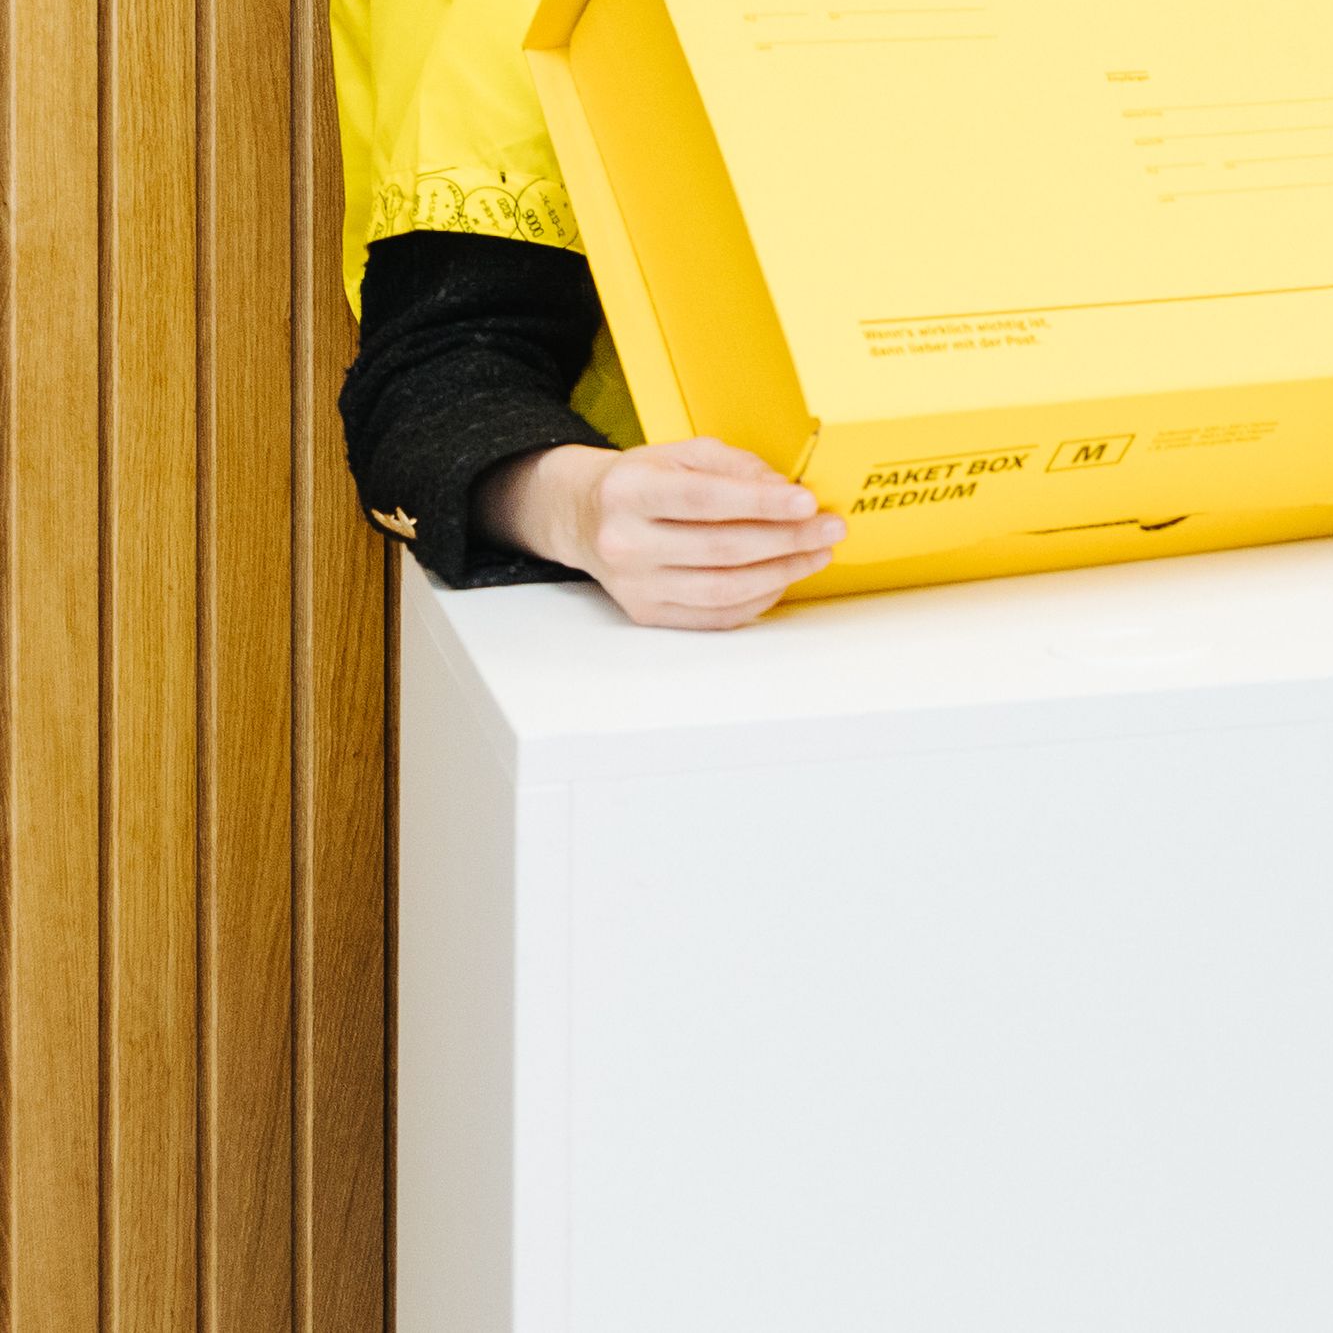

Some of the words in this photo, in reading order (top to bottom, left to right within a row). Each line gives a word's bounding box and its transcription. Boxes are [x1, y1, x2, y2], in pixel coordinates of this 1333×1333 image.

[521, 208, 545, 238] 9000
[862, 328, 914, 341] Wenn's
[918, 322, 973, 337] wirklich
[976, 318, 1027, 332] wichtig
[907, 340, 948, 354] lieber
[952, 338, 975, 350] mit
[979, 337, 1001, 348] der
[1005, 334, 1040, 346] Post.
[862, 463, 963, 491] PAKET
[966, 451, 1031, 477] BOX
[1072, 444, 1107, 464] M
[850, 481, 979, 515] MEDIUM
